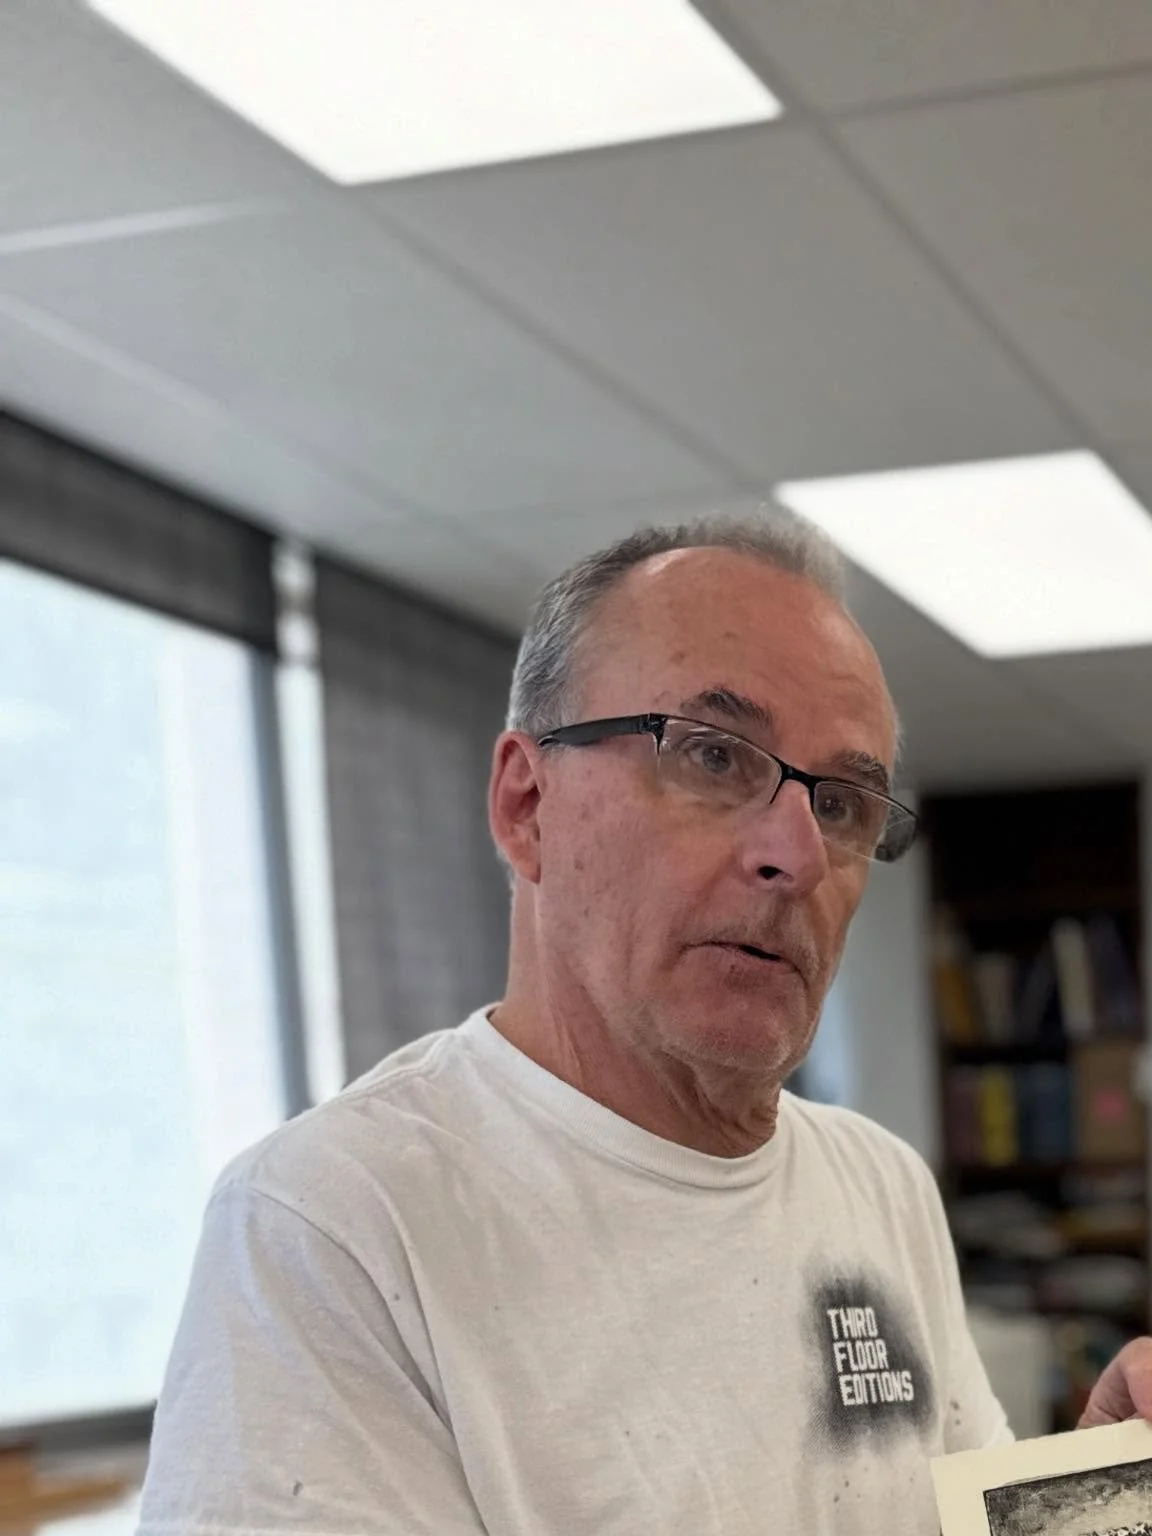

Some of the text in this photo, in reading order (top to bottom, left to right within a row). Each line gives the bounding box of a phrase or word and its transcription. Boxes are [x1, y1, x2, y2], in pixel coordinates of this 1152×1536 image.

[826, 1306, 879, 1340] THIRD
[832, 1338, 889, 1373] FLOOR
[838, 1370, 914, 1406] EDITIONS
